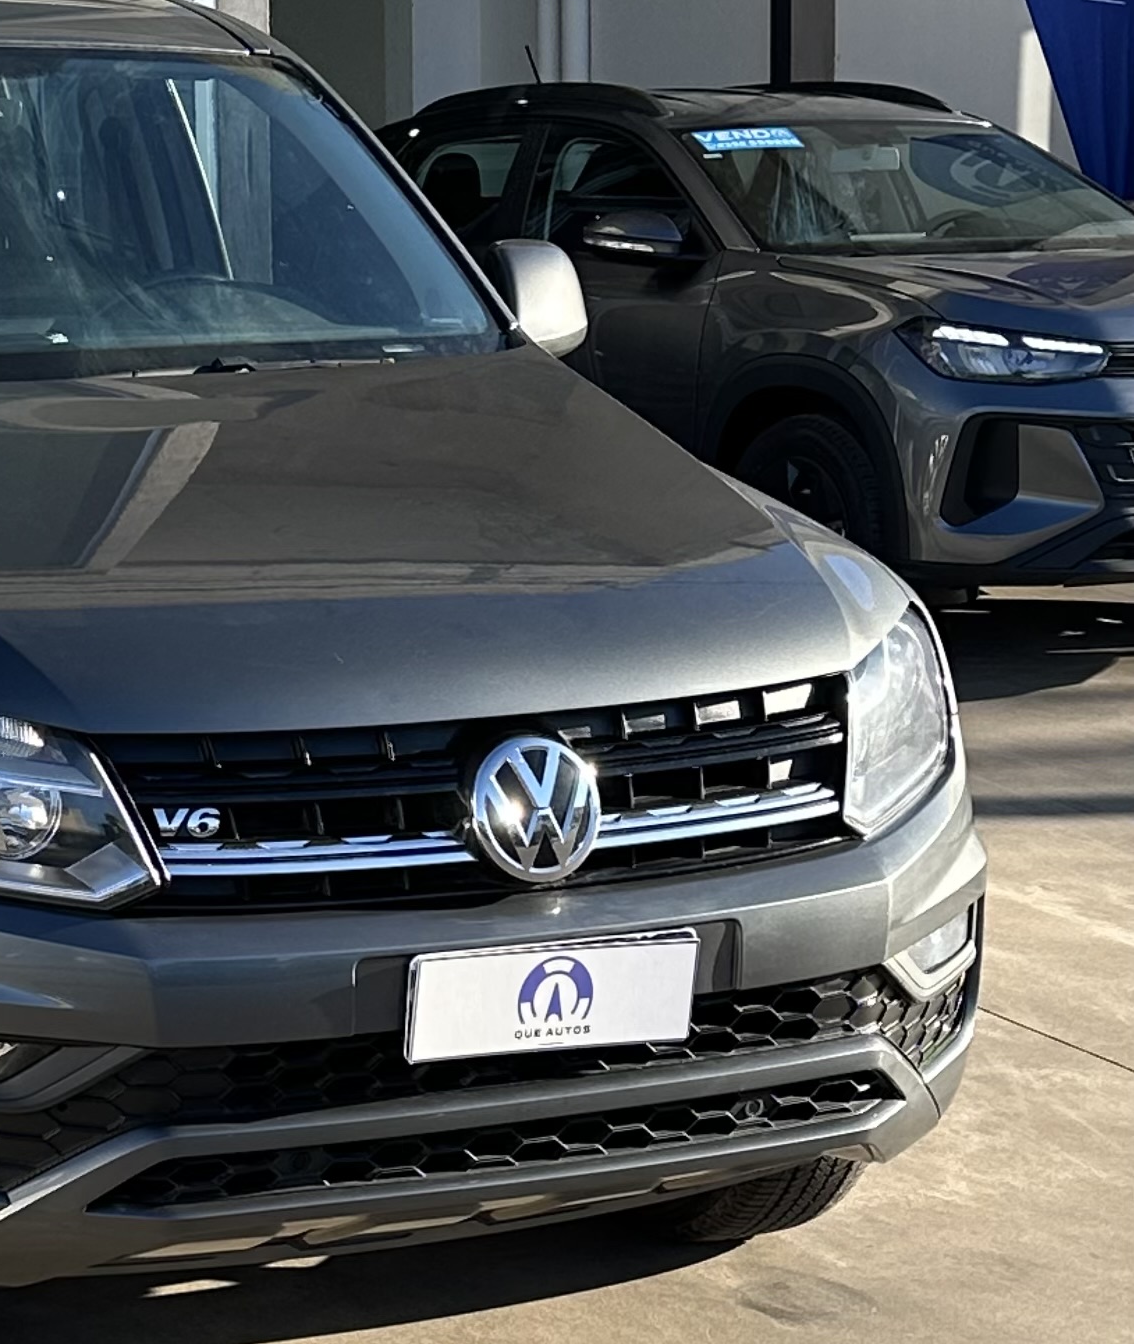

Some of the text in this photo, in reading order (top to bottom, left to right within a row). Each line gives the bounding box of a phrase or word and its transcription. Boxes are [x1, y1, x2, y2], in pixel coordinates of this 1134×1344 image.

[152, 807, 222, 839] V6
[514, 1024, 591, 1040] QUE AUTOS
